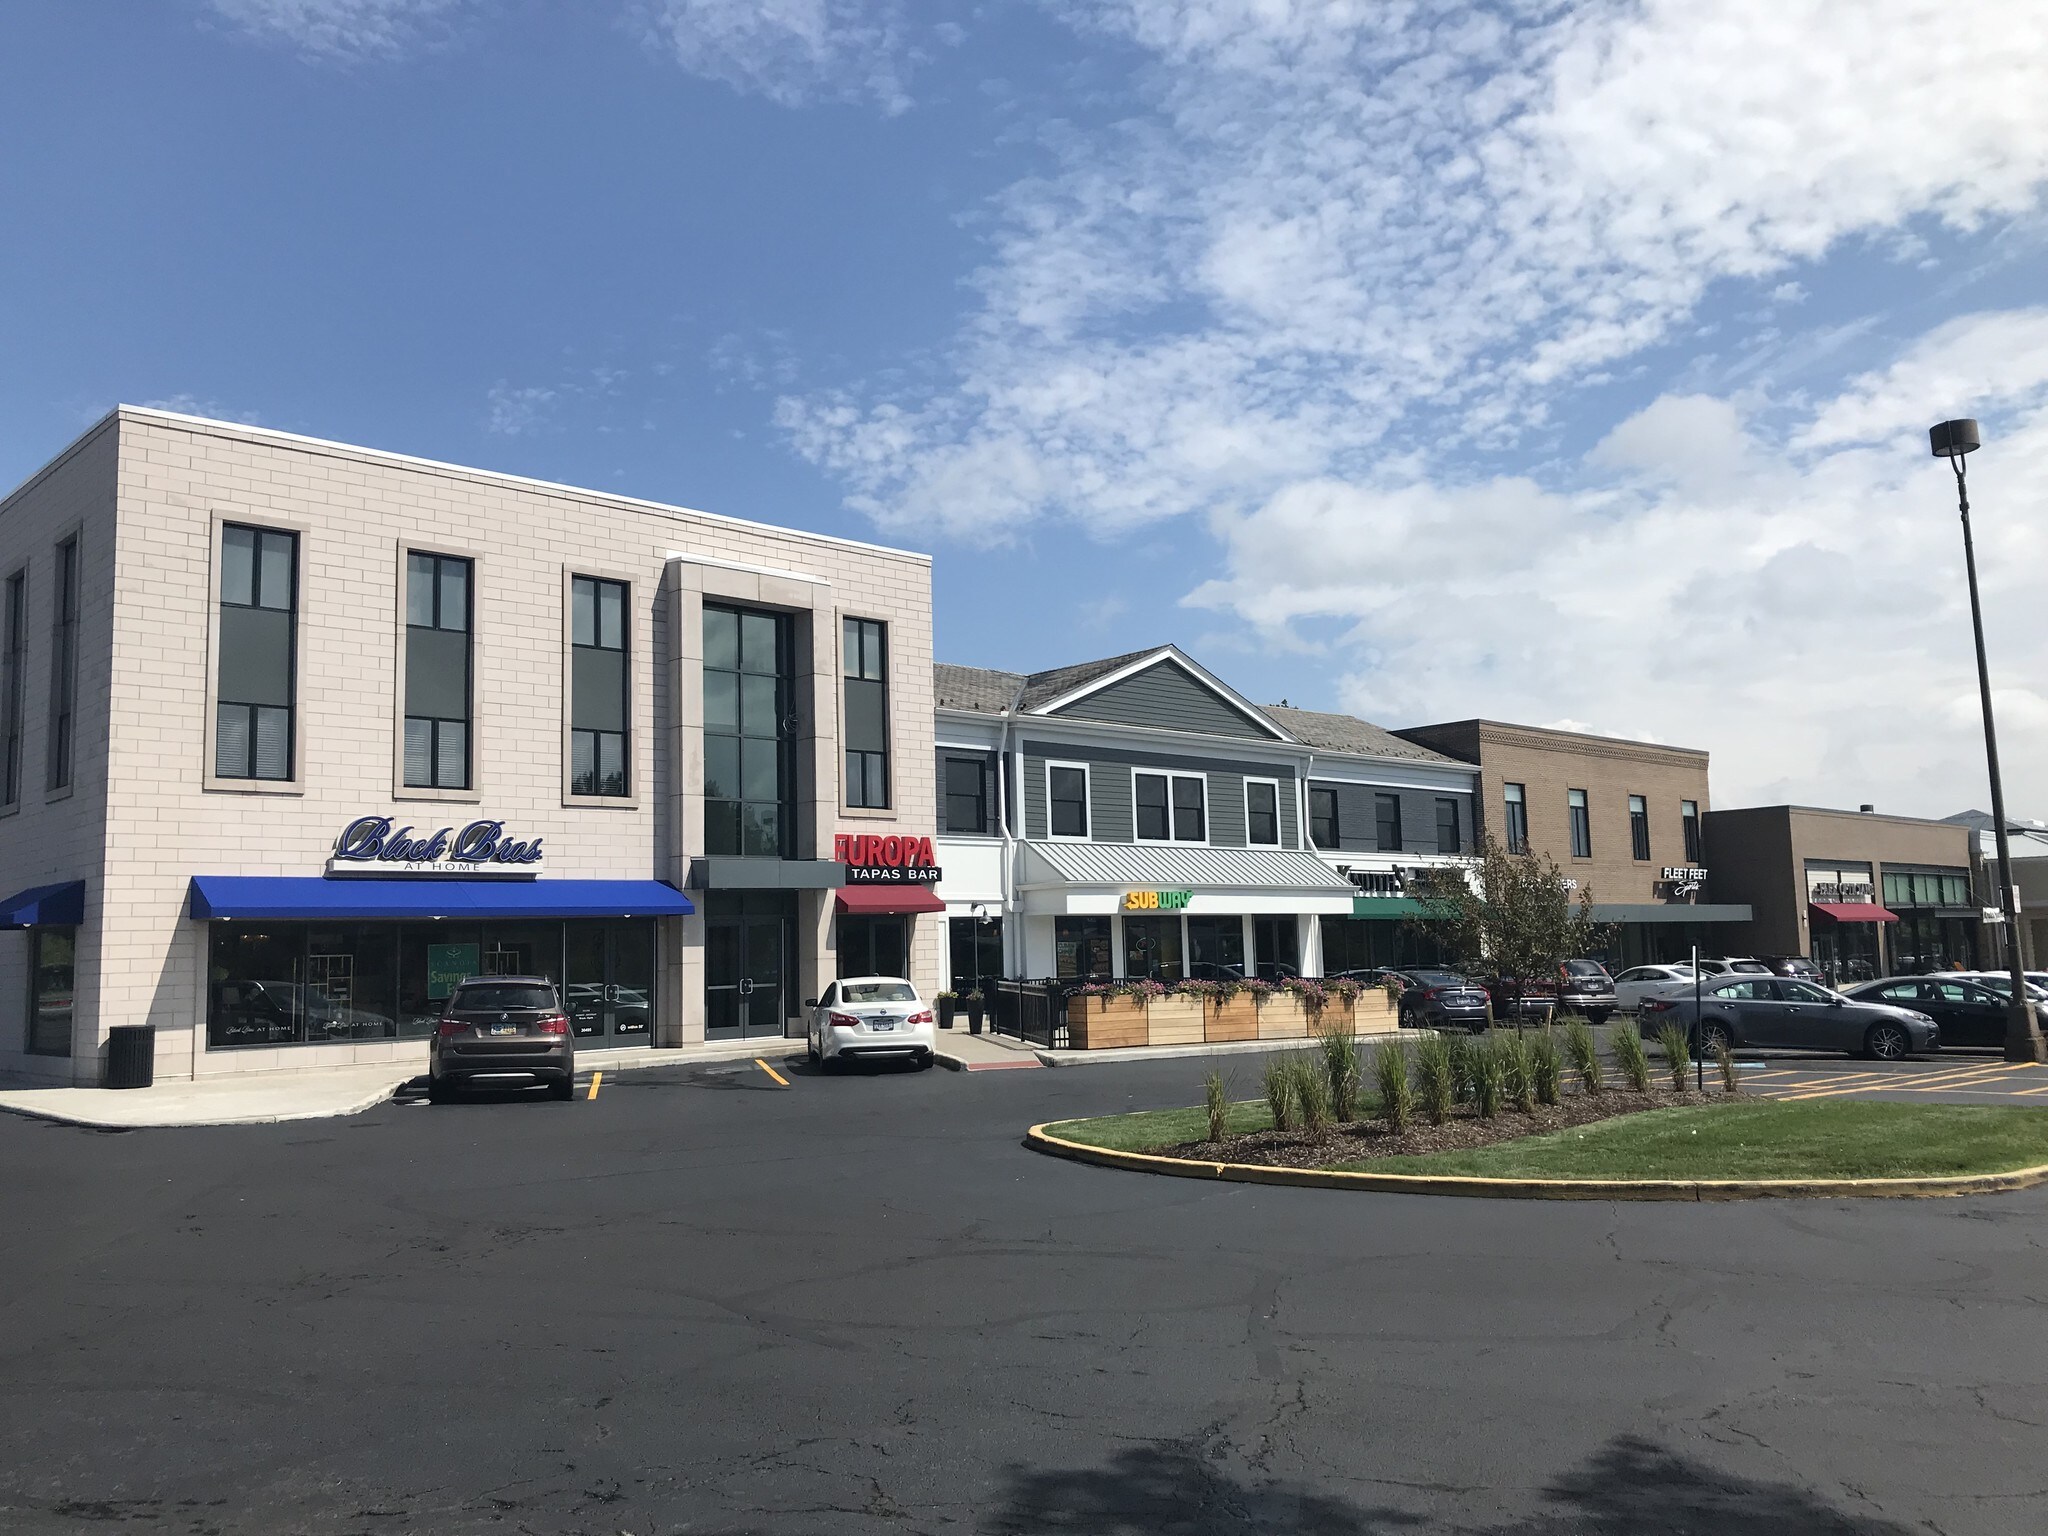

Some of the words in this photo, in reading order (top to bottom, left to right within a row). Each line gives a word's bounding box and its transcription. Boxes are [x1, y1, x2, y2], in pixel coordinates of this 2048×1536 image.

[337, 815, 454, 860] Block
[834, 833, 936, 868] EUROPA
[404, 862, 423, 871] AT
[432, 862, 481, 871] HOME
[851, 868, 901, 879] TAPAS
[908, 869, 938, 880] BAR
[1664, 867, 1688, 879] FLEET
[1689, 868, 1708, 880] FEET
[1123, 889, 1195, 910] SUBWAY
